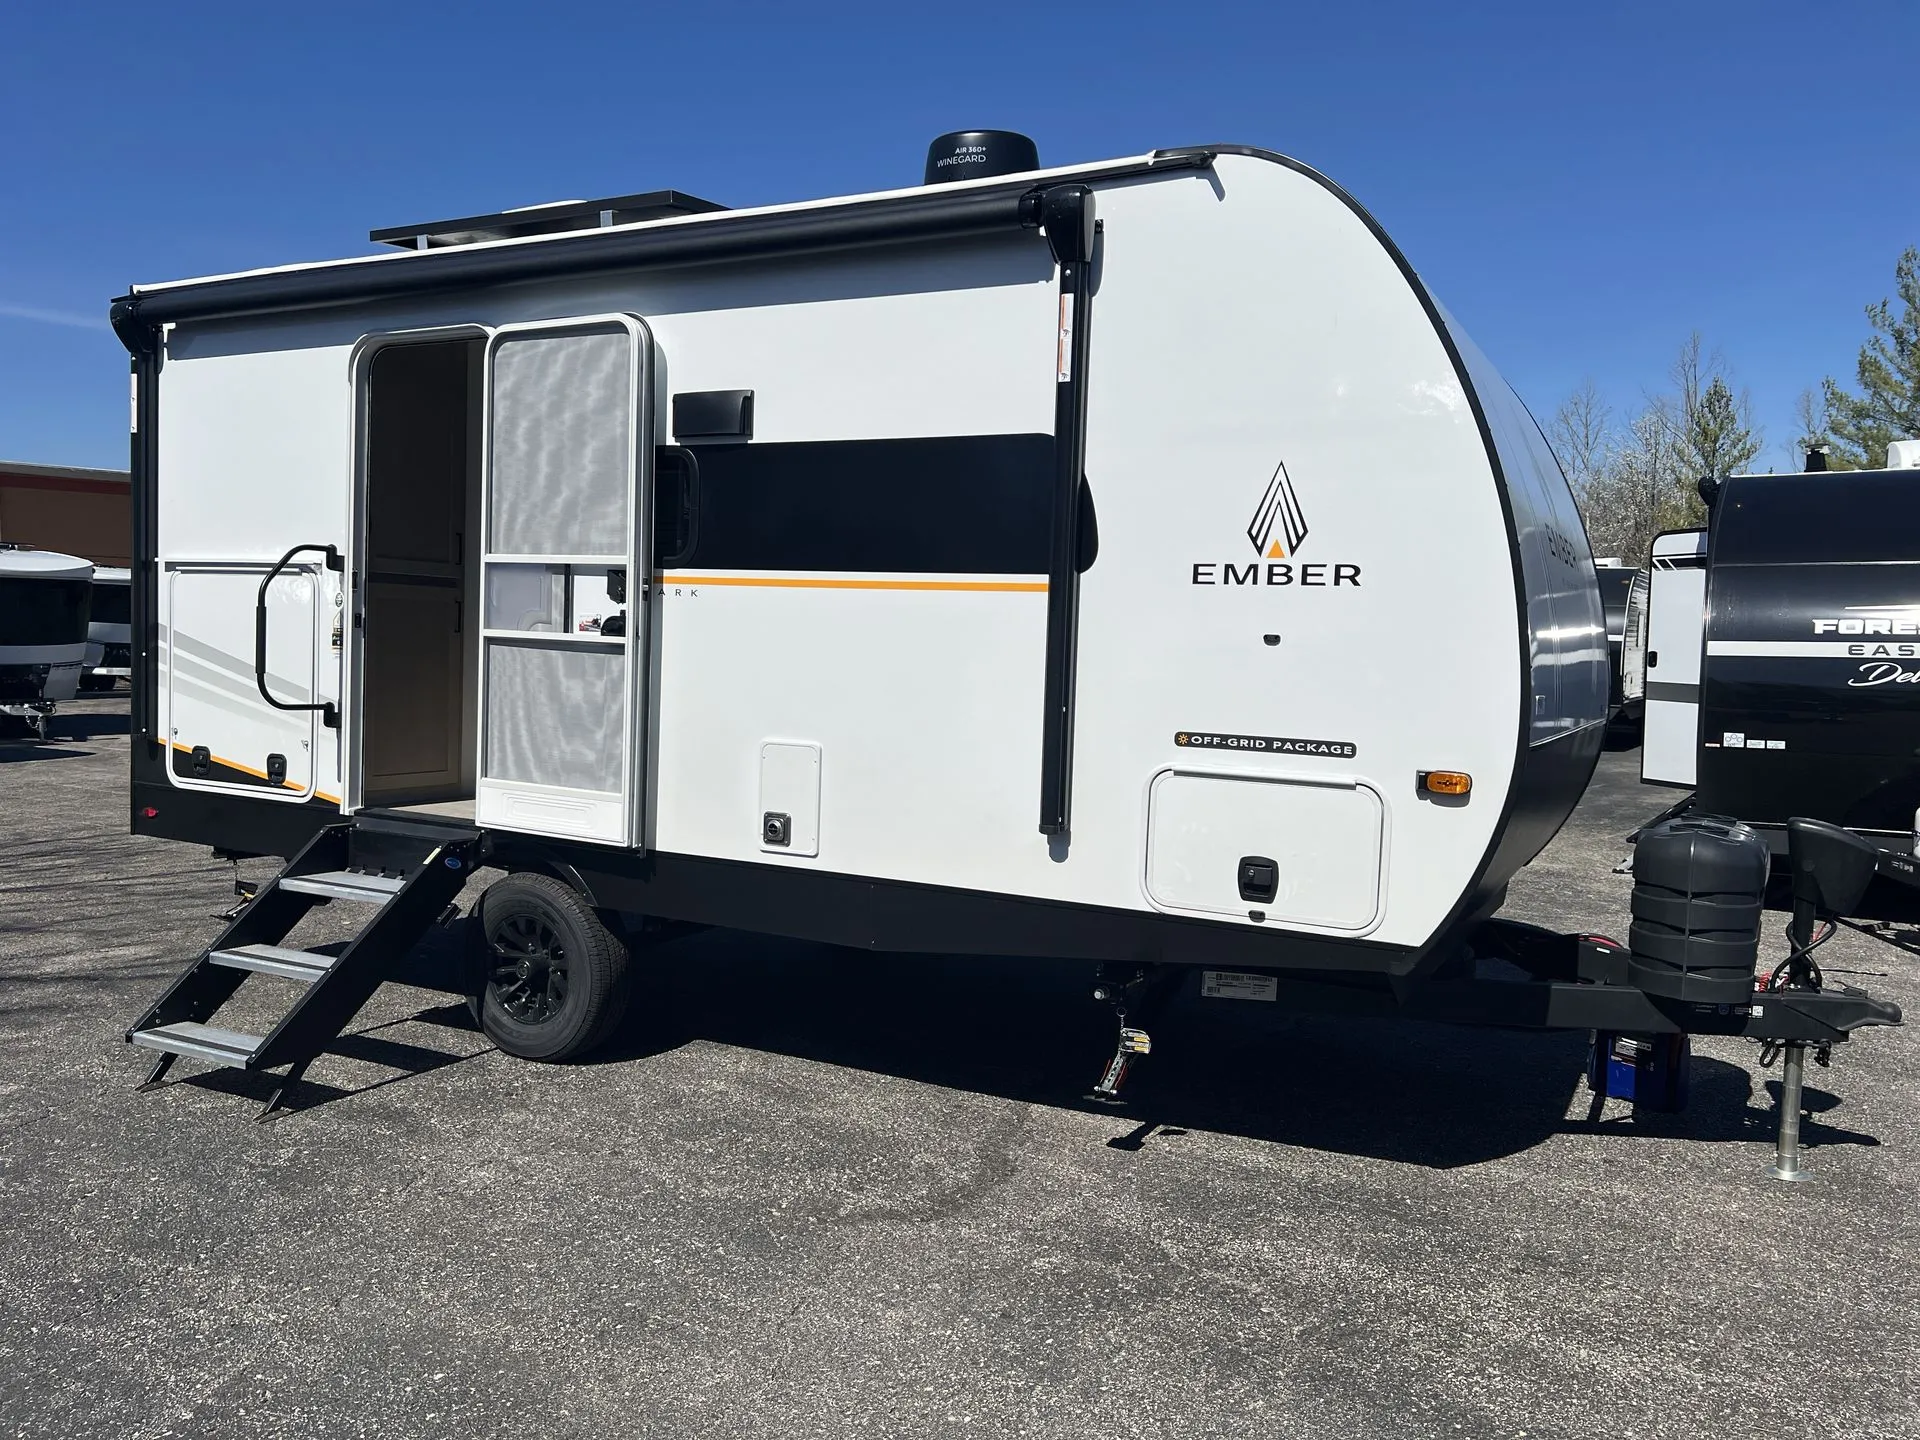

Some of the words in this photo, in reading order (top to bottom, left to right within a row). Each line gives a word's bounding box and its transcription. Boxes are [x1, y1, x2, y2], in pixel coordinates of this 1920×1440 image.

[955, 146, 967, 154] AIR
[937, 154, 987, 168] WINEGARD
[1545, 522, 1580, 573] EMBER
[1192, 563, 1362, 587] EMBER
[1812, 619, 1920, 635] FORE
[1190, 735, 1266, 749] OFF-GRID
[1272, 740, 1353, 755] PACKAGE
